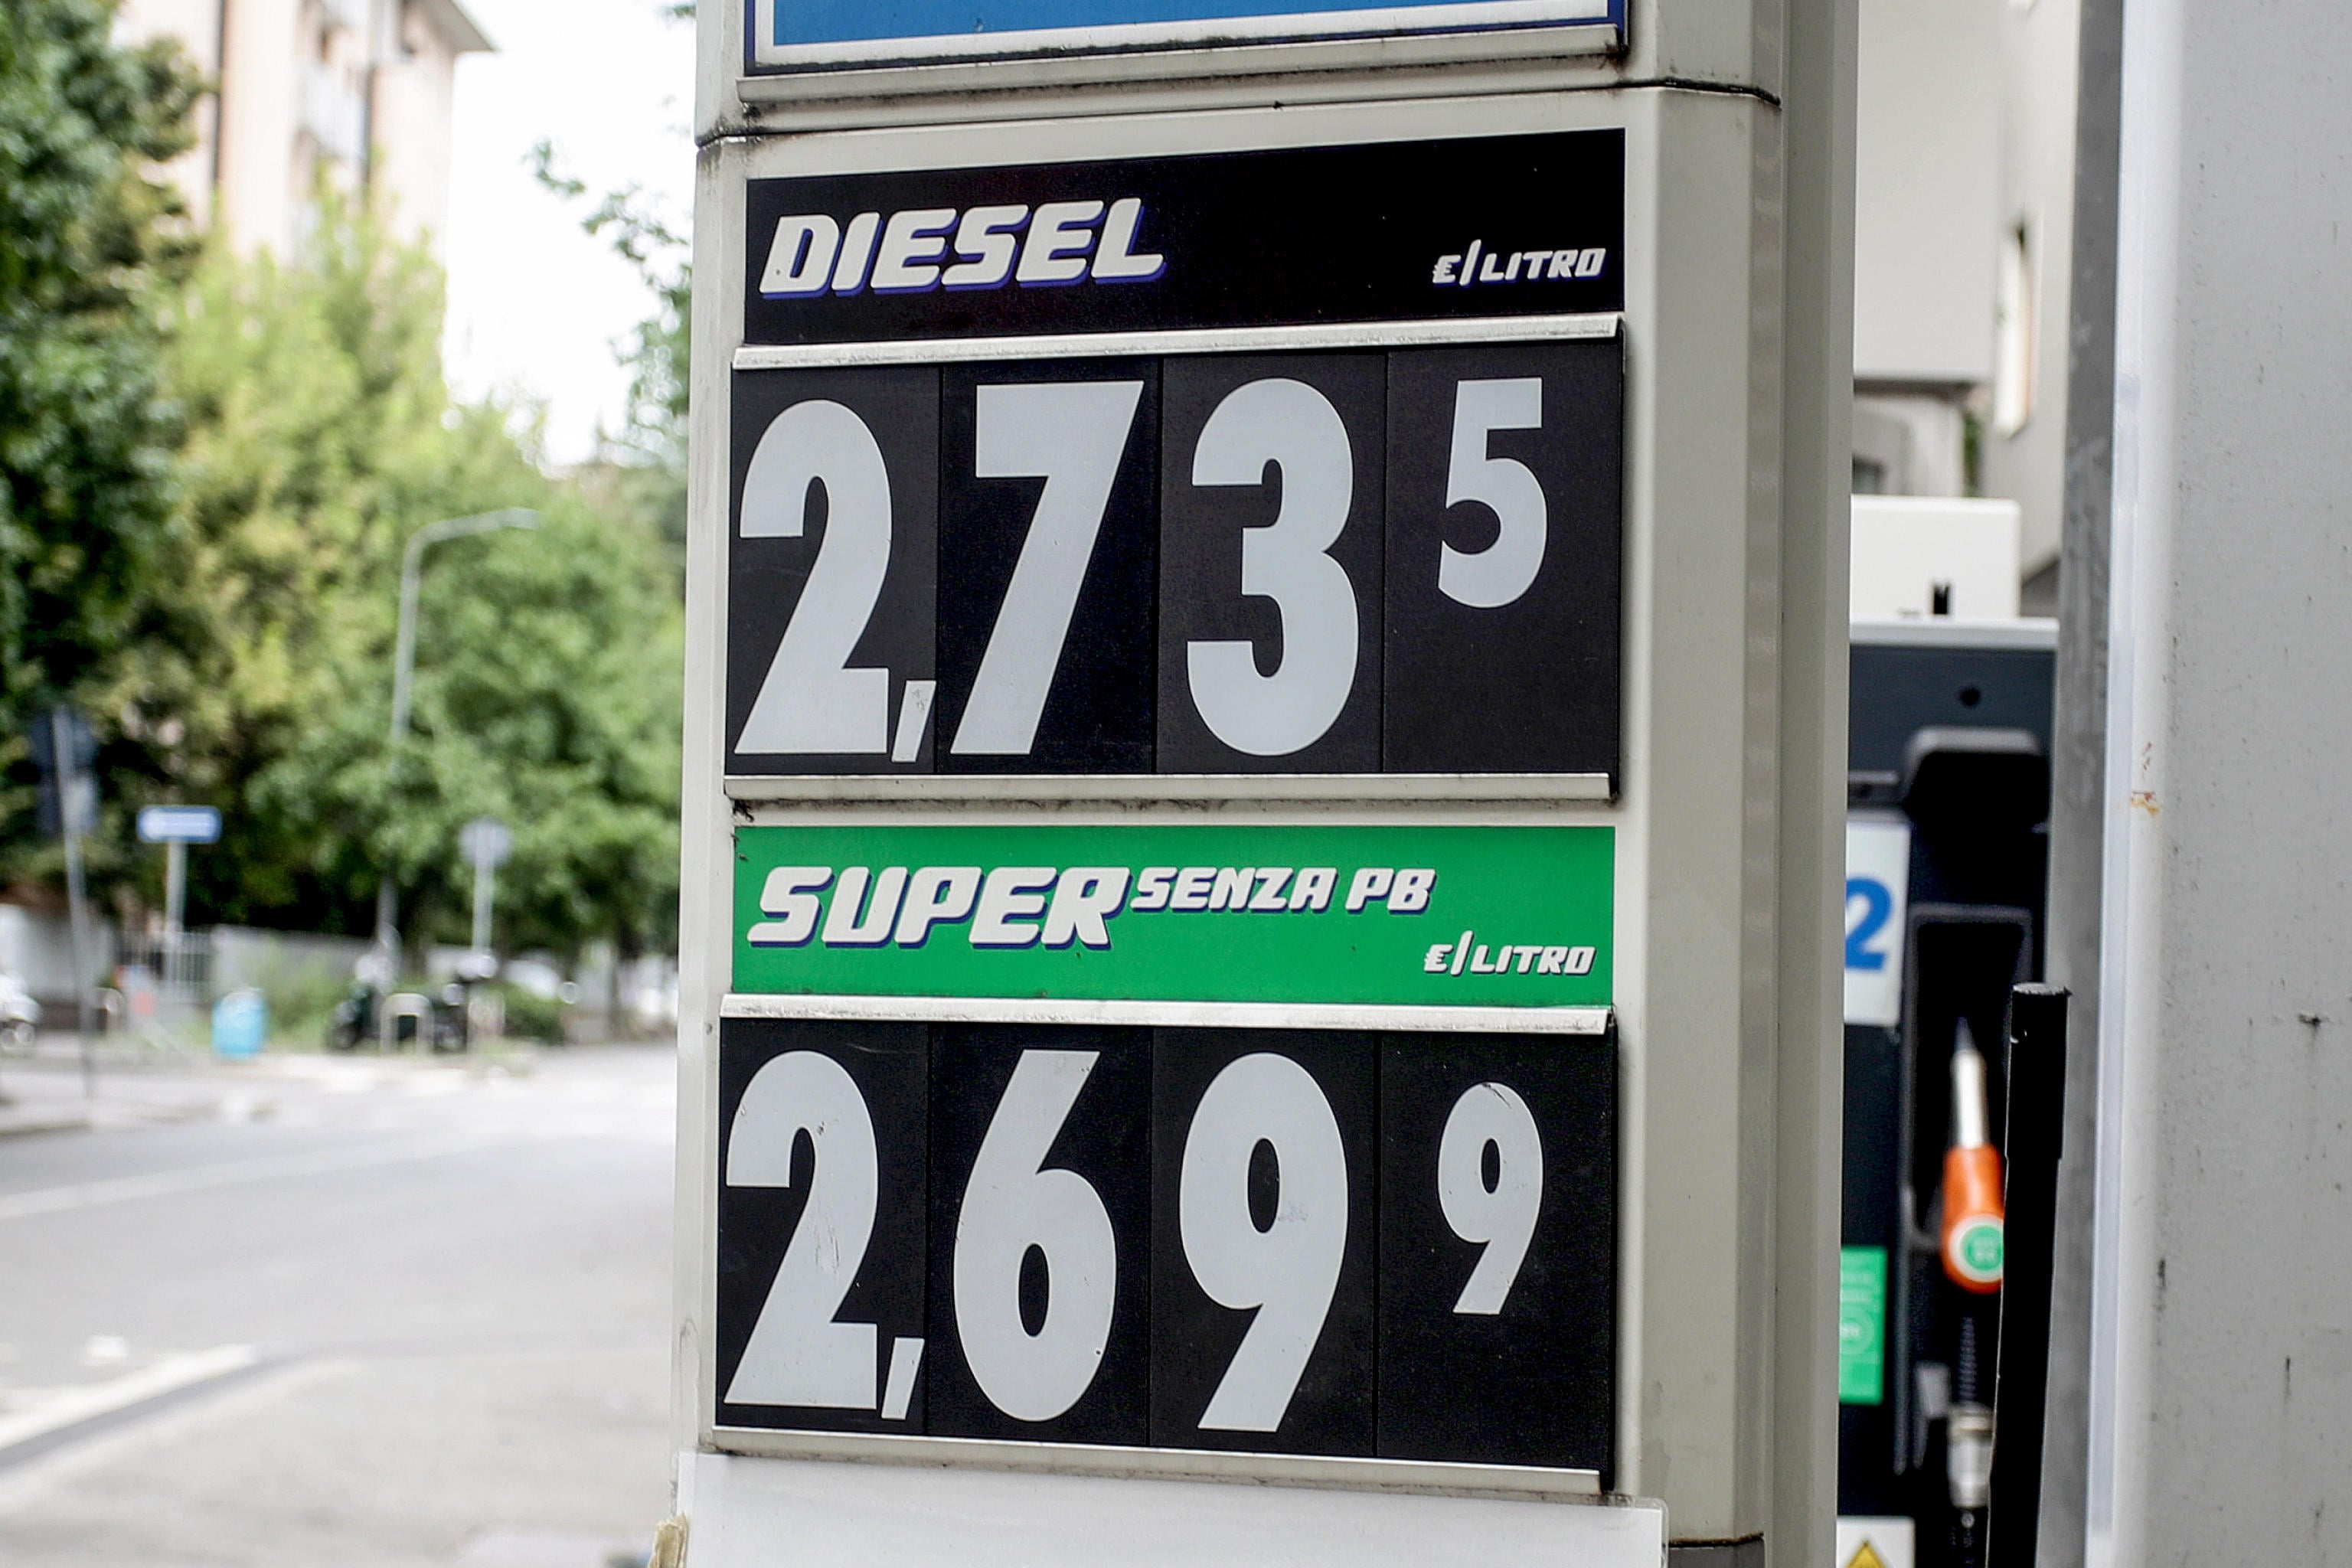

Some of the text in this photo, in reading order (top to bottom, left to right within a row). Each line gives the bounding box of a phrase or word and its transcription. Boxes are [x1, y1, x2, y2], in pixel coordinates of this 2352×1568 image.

[759, 197, 1166, 296] DIESEL
[746, 865, 1437, 948] SUPER SENZA PB
[1844, 877, 1893, 972] 2
